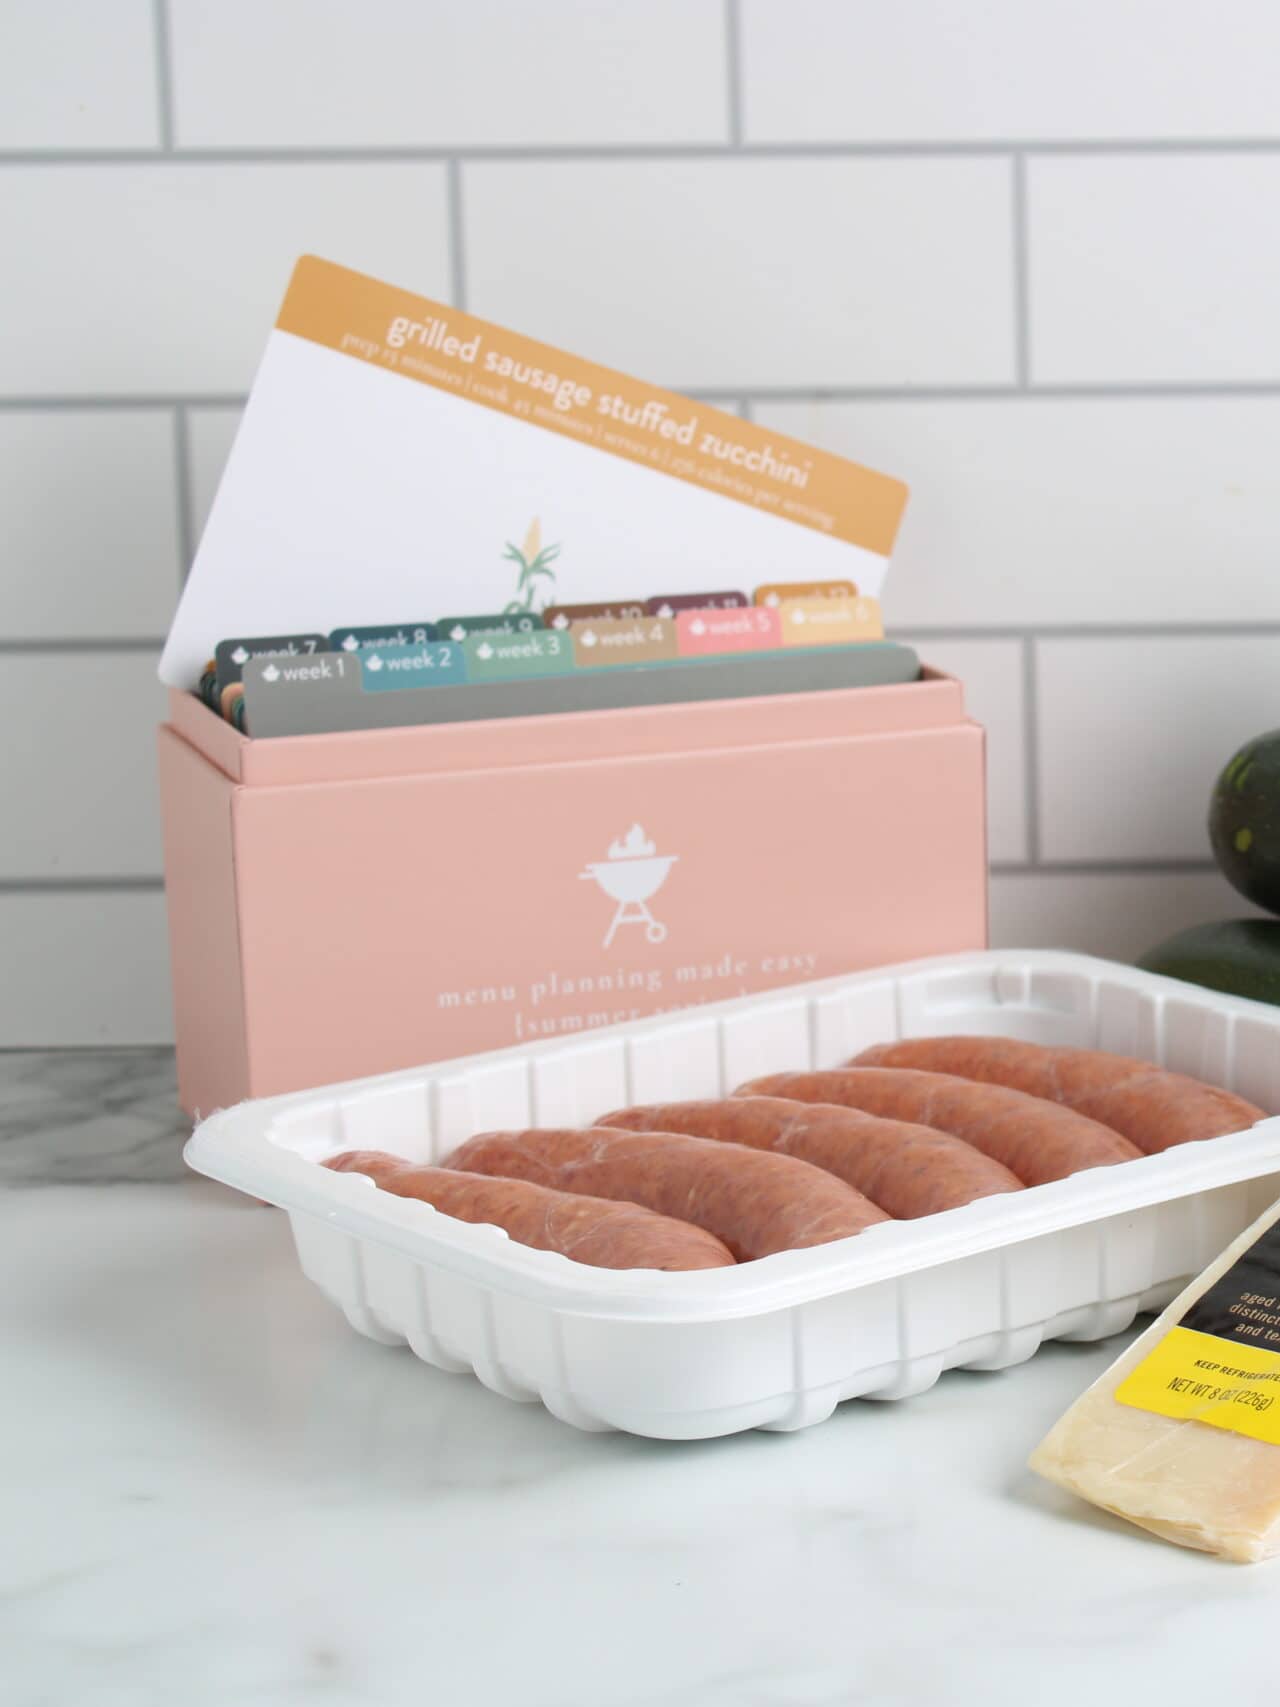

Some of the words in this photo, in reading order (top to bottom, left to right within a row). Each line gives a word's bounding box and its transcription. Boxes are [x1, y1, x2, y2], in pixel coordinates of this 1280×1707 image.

[387, 316, 482, 363] grilled
[484, 351, 592, 411] sausage
[597, 394, 698, 445] stuffed
[699, 434, 813, 488] zucchini
[601, 624, 645, 647] week
[648, 623, 665, 644] 4
[708, 614, 753, 635] week
[756, 612, 772, 633] 5
[303, 640, 318, 656] 7
[361, 629, 408, 649] week
[414, 627, 428, 645] 8
[495, 636, 544, 659] week
[546, 635, 560, 656] 3
[283, 657, 334, 681] week
[336, 657, 346, 678] 1
[386, 648, 435, 672] week
[438, 647, 452, 668] 2
[438, 985, 516, 1010] menu
[529, 967, 663, 1008] planning
[674, 952, 749, 984] made
[761, 952, 817, 977] easy
[1240, 1291, 1278, 1308] aged
[1234, 1321, 1263, 1338] and
[1194, 1359, 1220, 1372] KEEP
[1166, 1376, 1195, 1393] NET
[1191, 1382, 1213, 1398] WT
[1208, 1387, 1222, 1400] 8
[1233, 1390, 1276, 1412] (226g)
